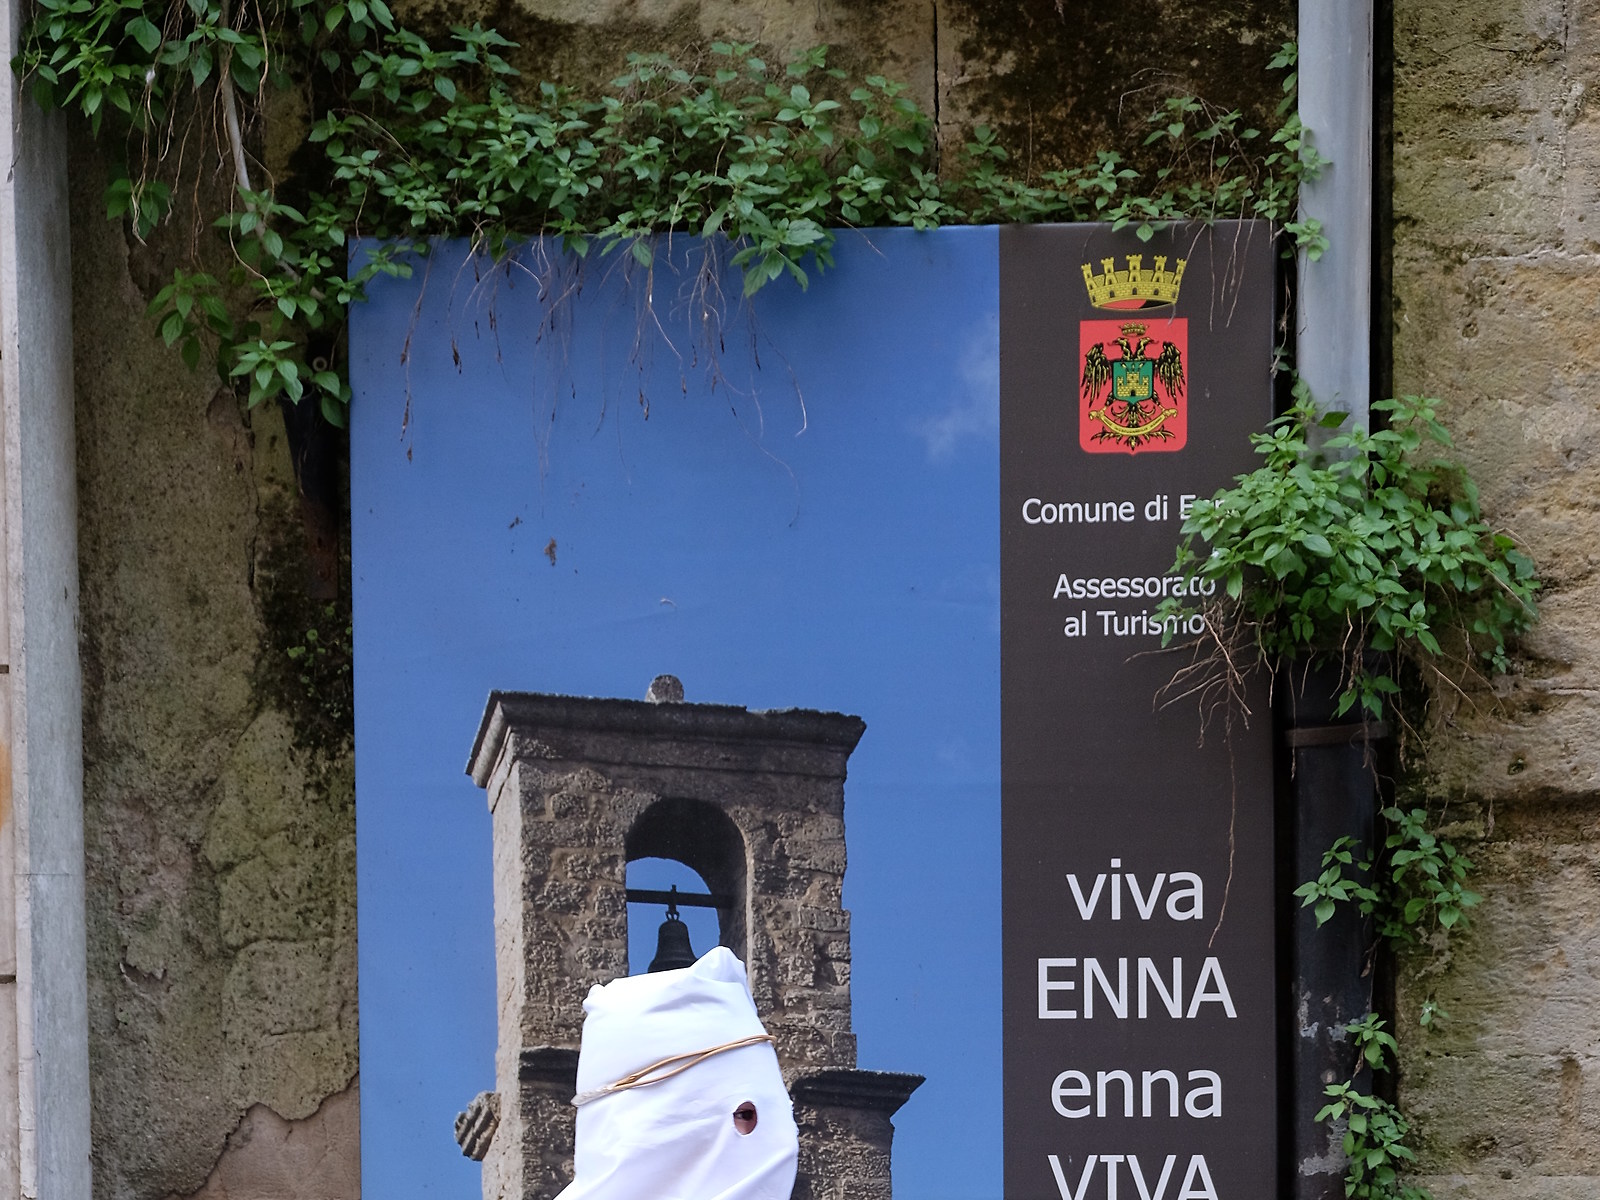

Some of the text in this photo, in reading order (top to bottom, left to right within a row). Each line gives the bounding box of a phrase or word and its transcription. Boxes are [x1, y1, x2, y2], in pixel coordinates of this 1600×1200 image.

[1022, 498, 1135, 525] Comune
[1144, 495, 1168, 522] di
[1053, 574, 1216, 599] Assessorato
[1064, 610, 1206, 637] al Turismo
[1066, 858, 1204, 921] viva
[1038, 956, 1238, 1020] ENNA
[1051, 1069, 1222, 1119] enna
